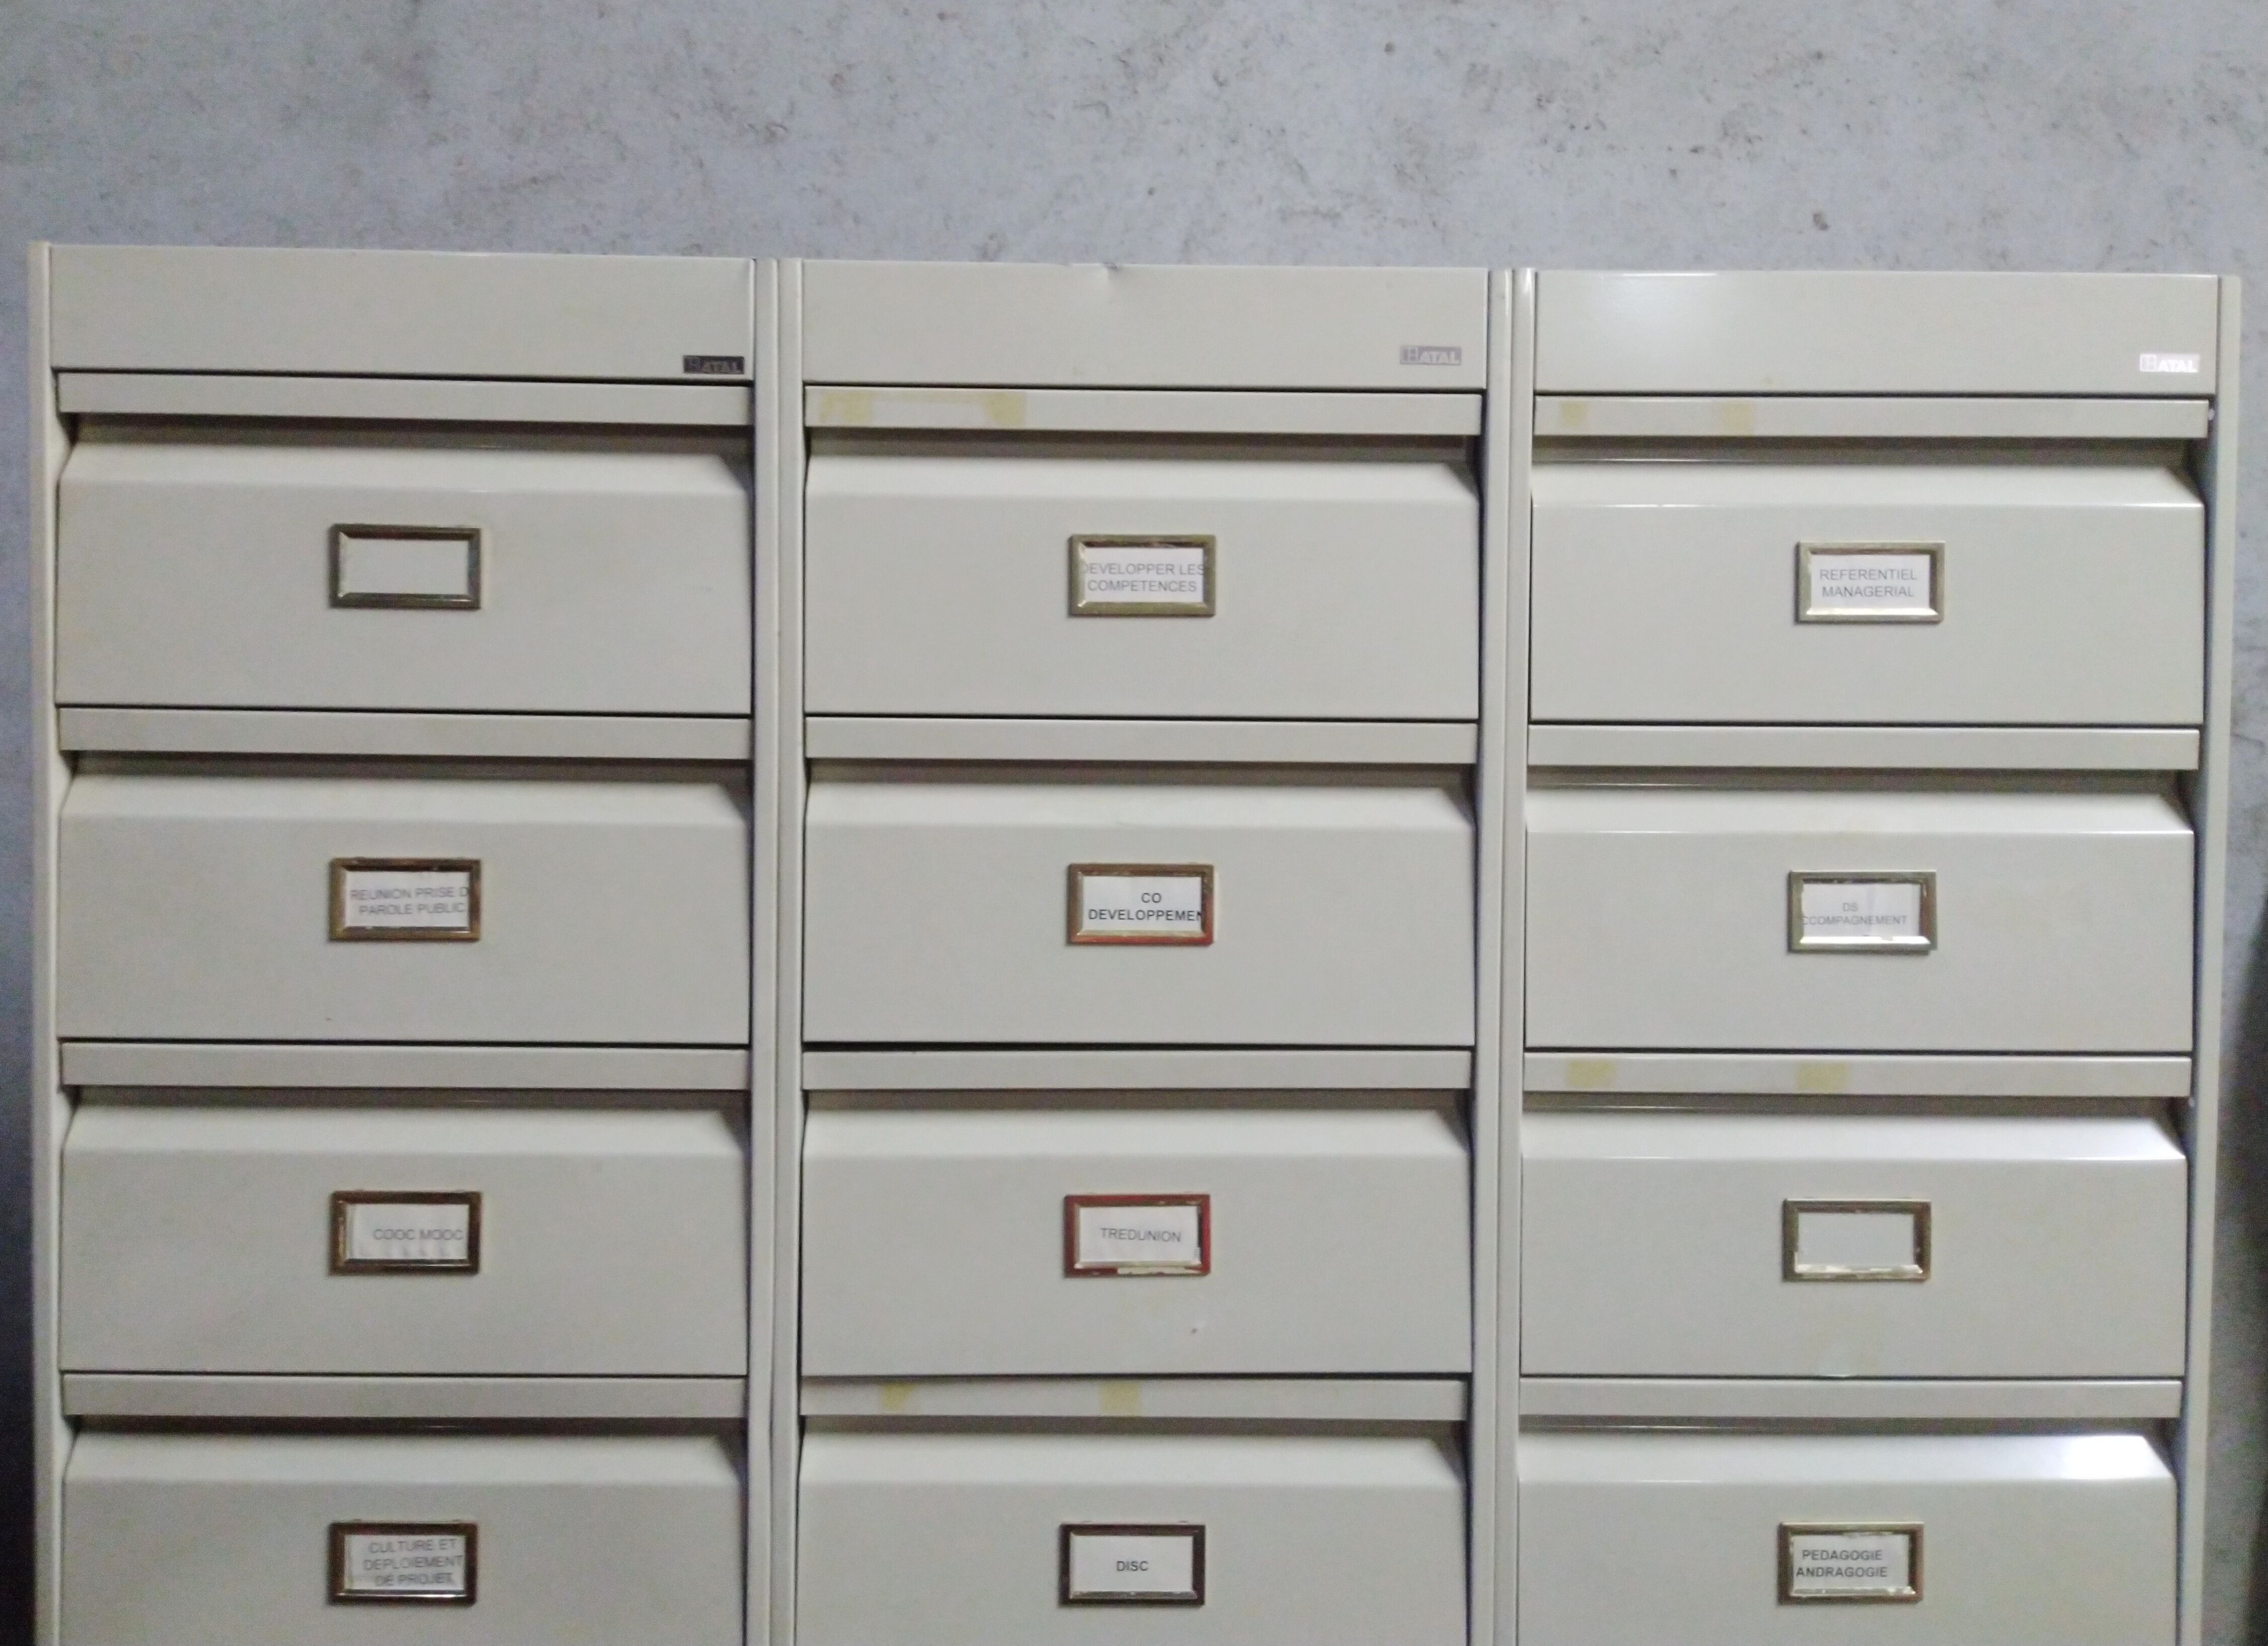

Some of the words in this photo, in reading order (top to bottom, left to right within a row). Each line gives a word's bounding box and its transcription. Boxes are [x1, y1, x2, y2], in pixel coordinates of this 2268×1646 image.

[1820, 569, 1918, 580] REFERENTIEL
[1088, 580, 1197, 592] COMPETENCES
[1822, 586, 1915, 597] MANAGERIAL
[1141, 893, 1162, 903] CO
[1100, 1227, 1182, 1242] TREDUNION
[439, 1539, 456, 1550] ET
[1802, 1550, 1883, 1560] PEDAGOGIE
[1116, 1560, 1149, 1571] DISC
[1796, 1566, 1887, 1578] ANDRAGOGIE
